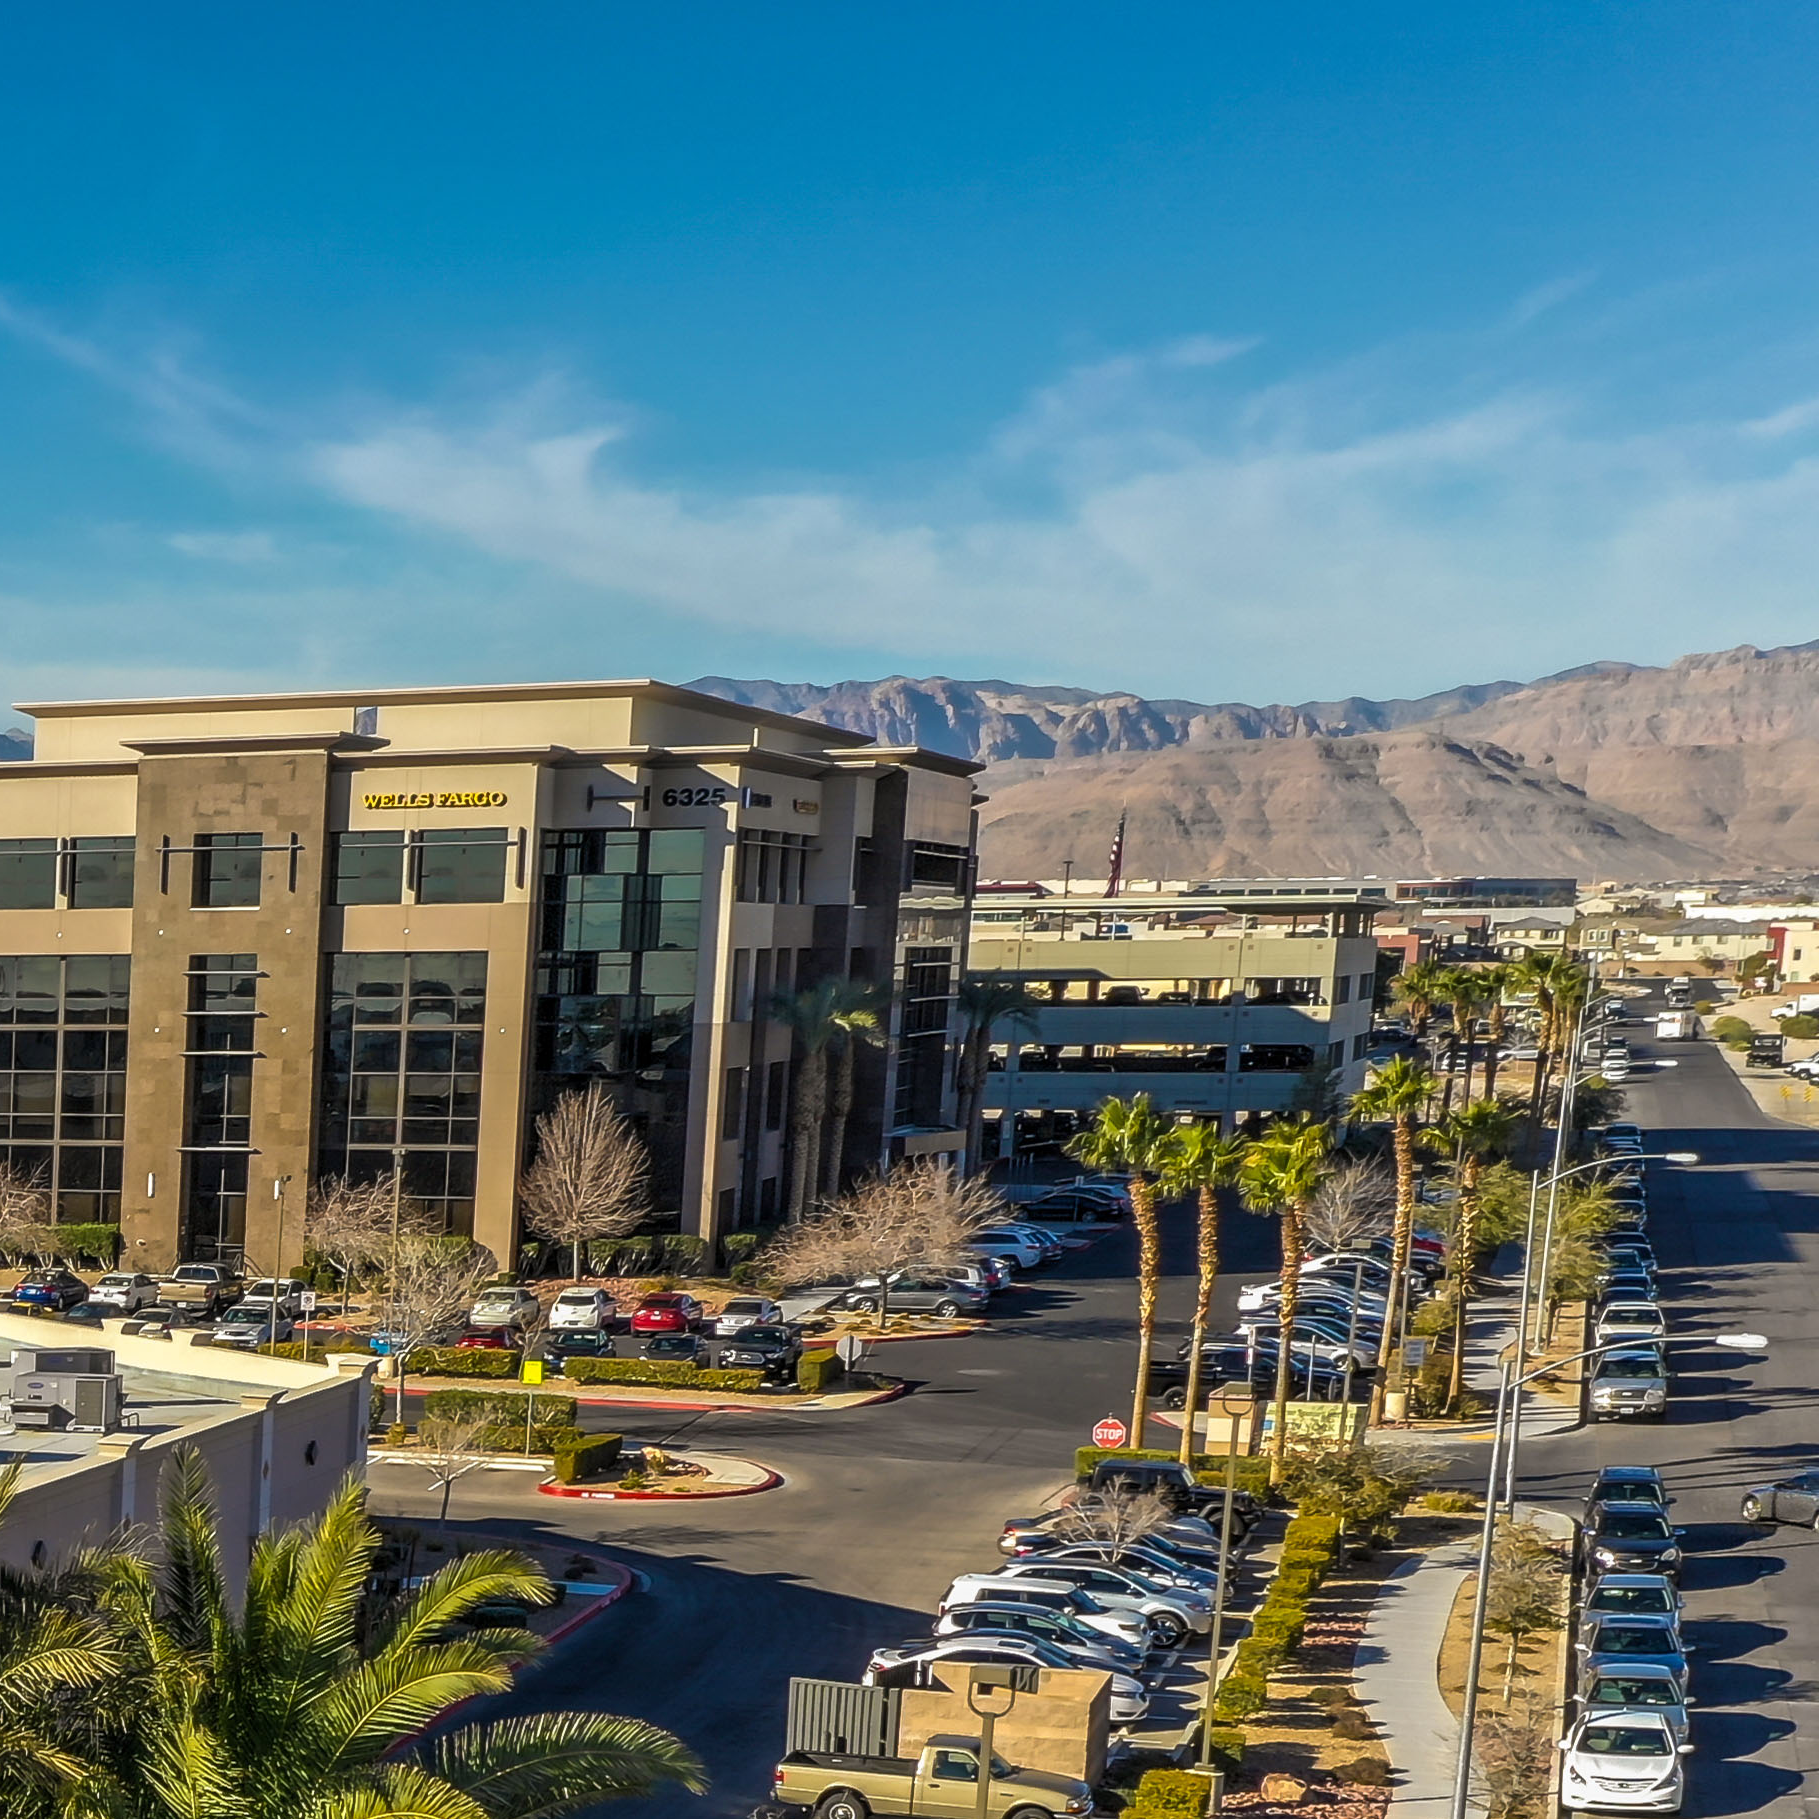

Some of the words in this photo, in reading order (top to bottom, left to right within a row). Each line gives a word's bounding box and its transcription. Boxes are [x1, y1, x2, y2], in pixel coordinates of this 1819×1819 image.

[363, 792, 434, 810] WELLS
[435, 791, 508, 808] FARGO
[662, 787, 726, 807] 6325
[1095, 1428, 1123, 1441] STOP
